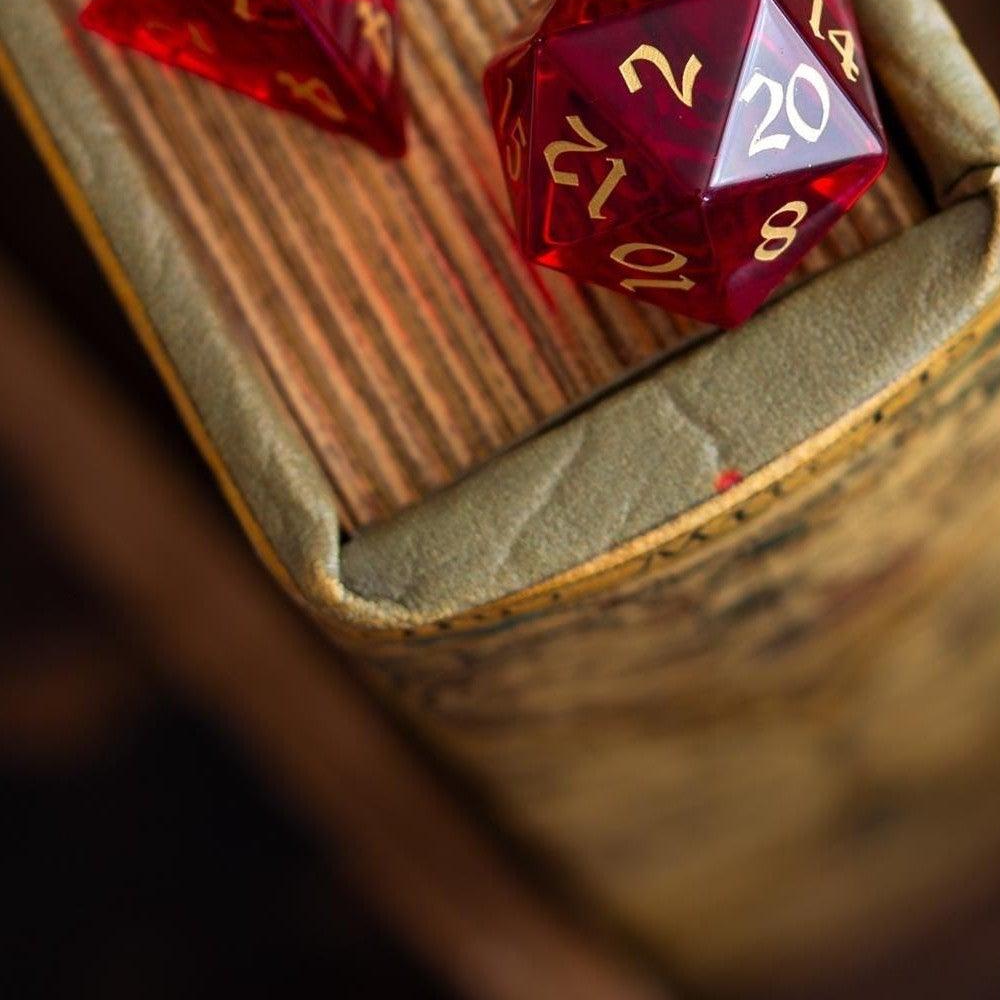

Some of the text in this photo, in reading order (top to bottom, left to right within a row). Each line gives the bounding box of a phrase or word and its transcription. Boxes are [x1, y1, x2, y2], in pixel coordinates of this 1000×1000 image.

[618, 44, 702, 108] 2
[739, 63, 831, 158] 20
[543, 115, 628, 220] 12
[754, 200, 808, 262] 8
[610, 242, 696, 293] 10
